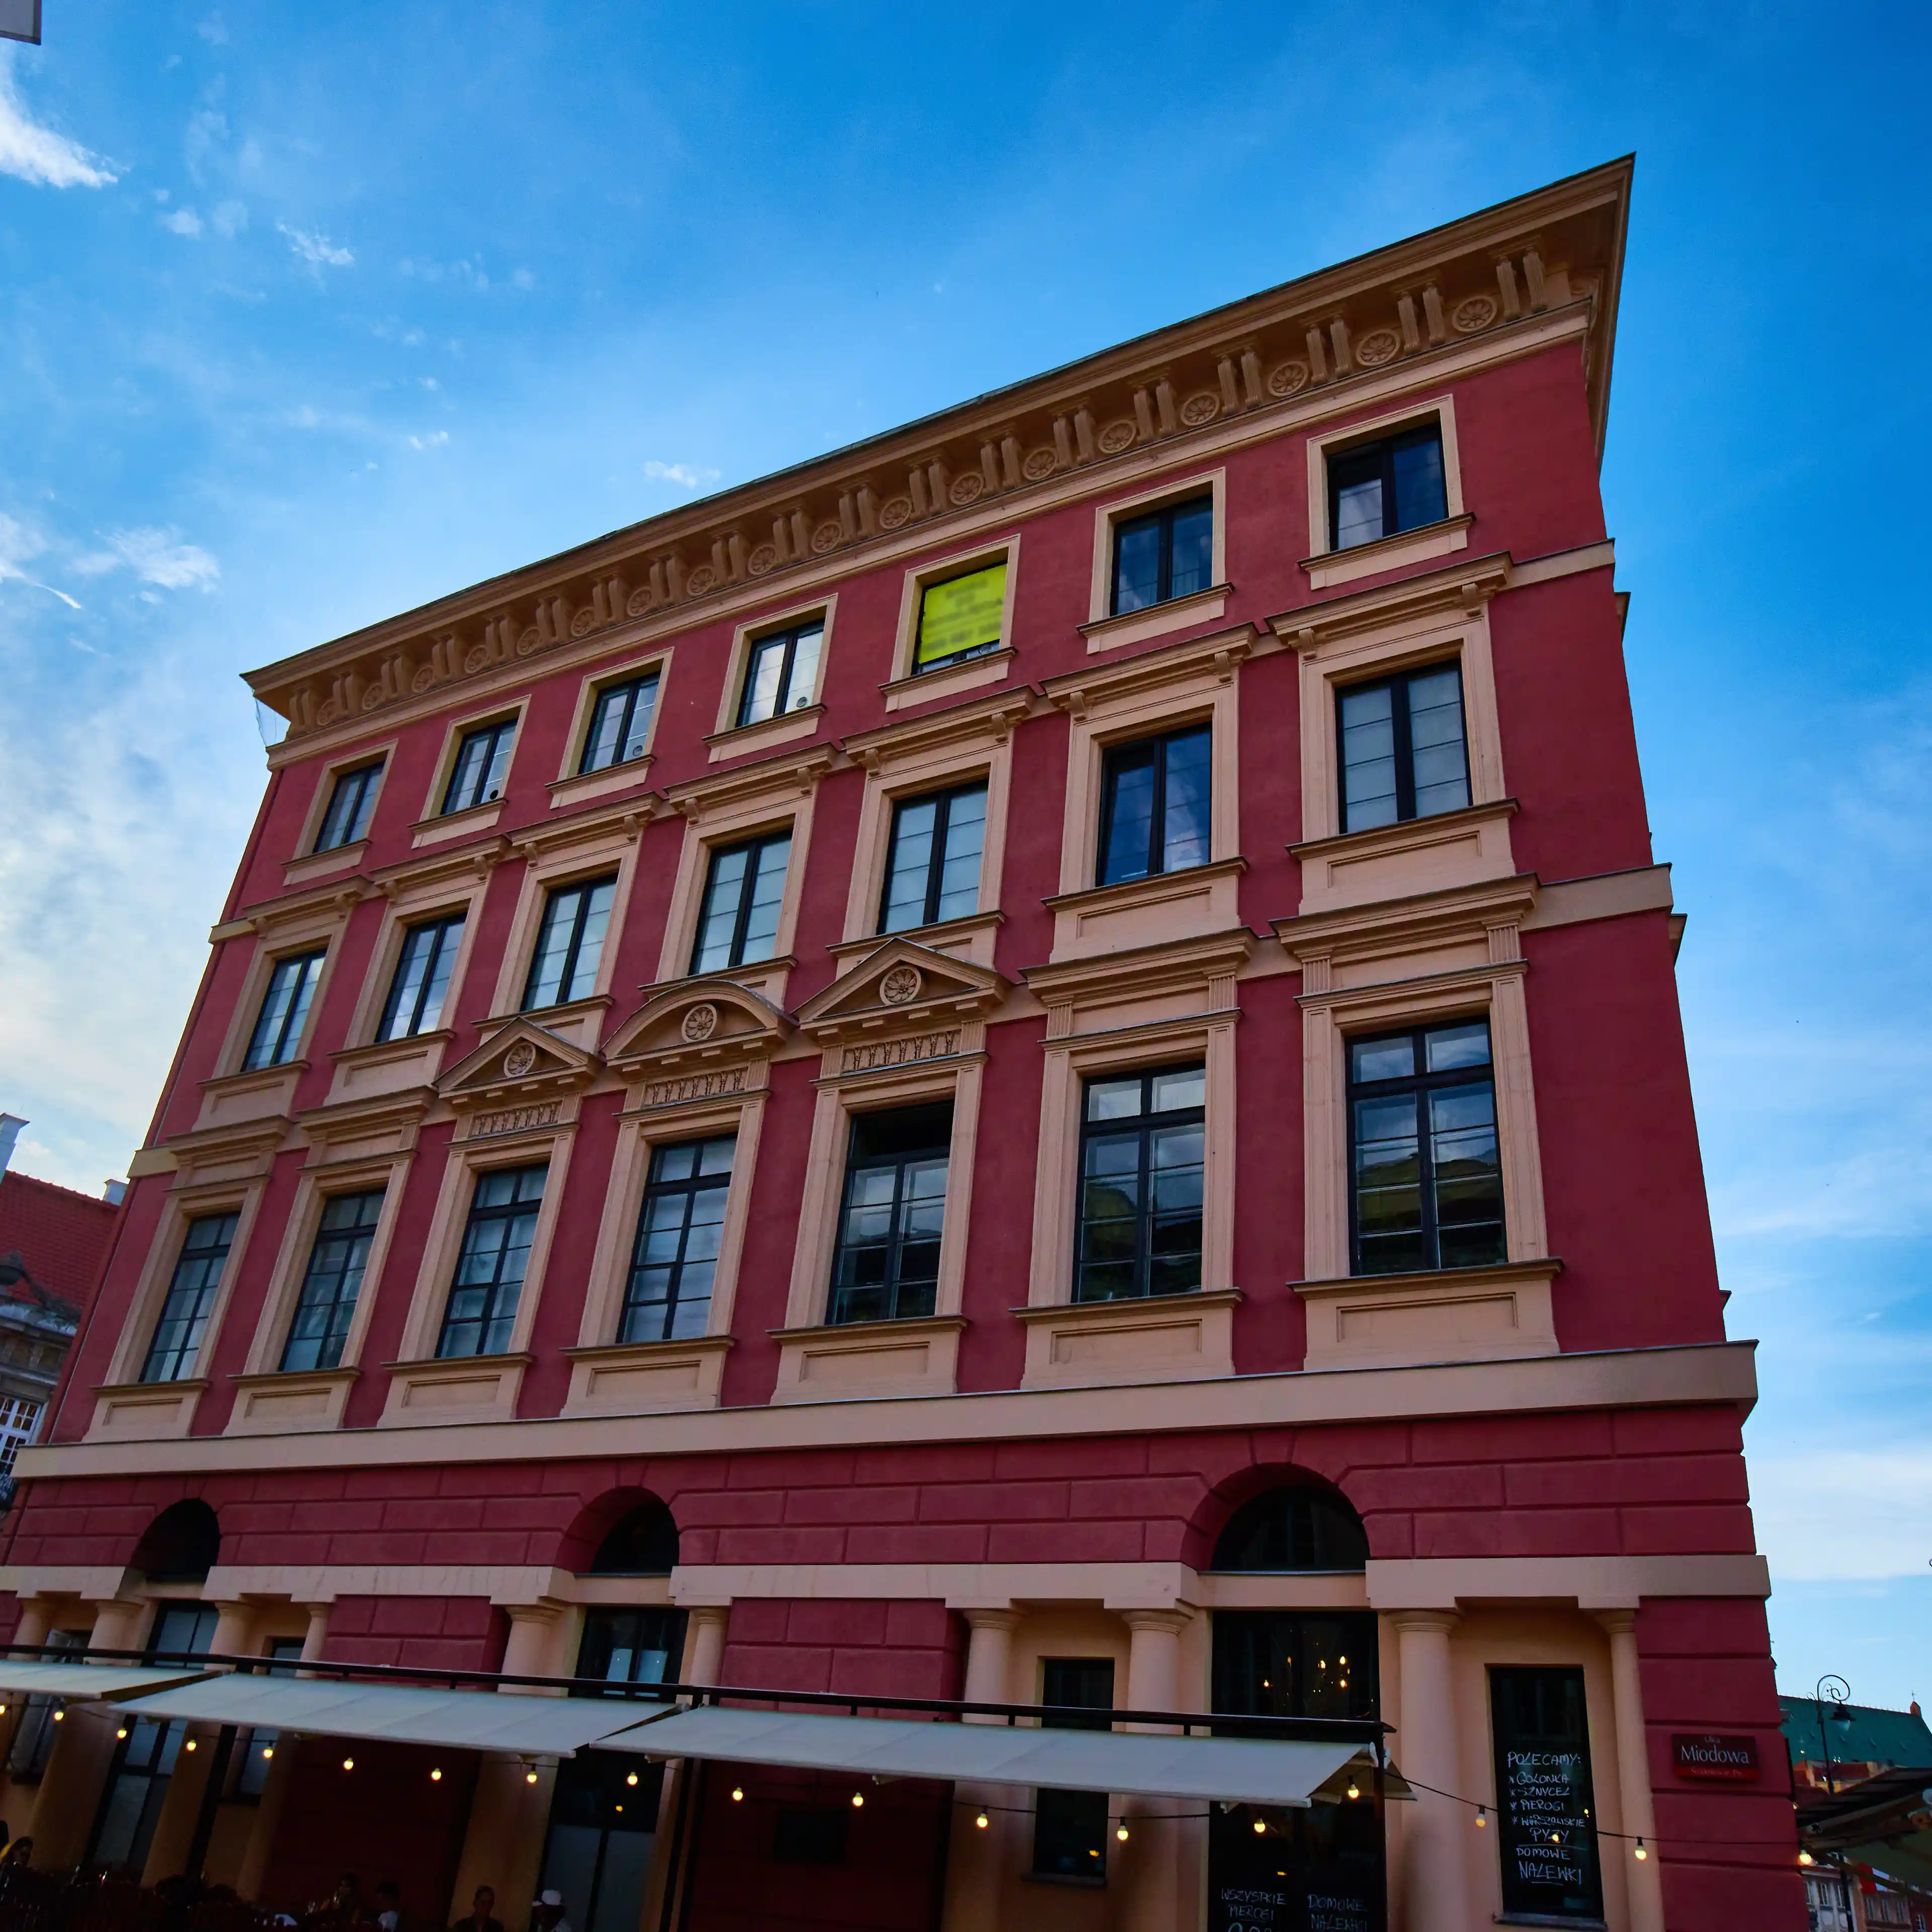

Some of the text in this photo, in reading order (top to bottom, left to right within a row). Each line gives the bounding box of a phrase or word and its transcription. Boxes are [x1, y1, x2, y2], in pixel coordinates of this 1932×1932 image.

[1507, 1751, 1581, 1768] POLECAMY:
[1681, 1744, 1749, 1764] Miodowa
[1516, 1772, 1571, 1785] GOLONKA
[1520, 1799, 1564, 1811] PIEROGI
[1515, 1848, 1571, 1860] DOMOWE
[1518, 1860, 1581, 1885] NALEWKI
[1221, 1888, 1286, 1905] WSZYSTKIE
[1308, 1894, 1368, 1912] DOMOWE
[1228, 1903, 1274, 1921] PIEROGI
